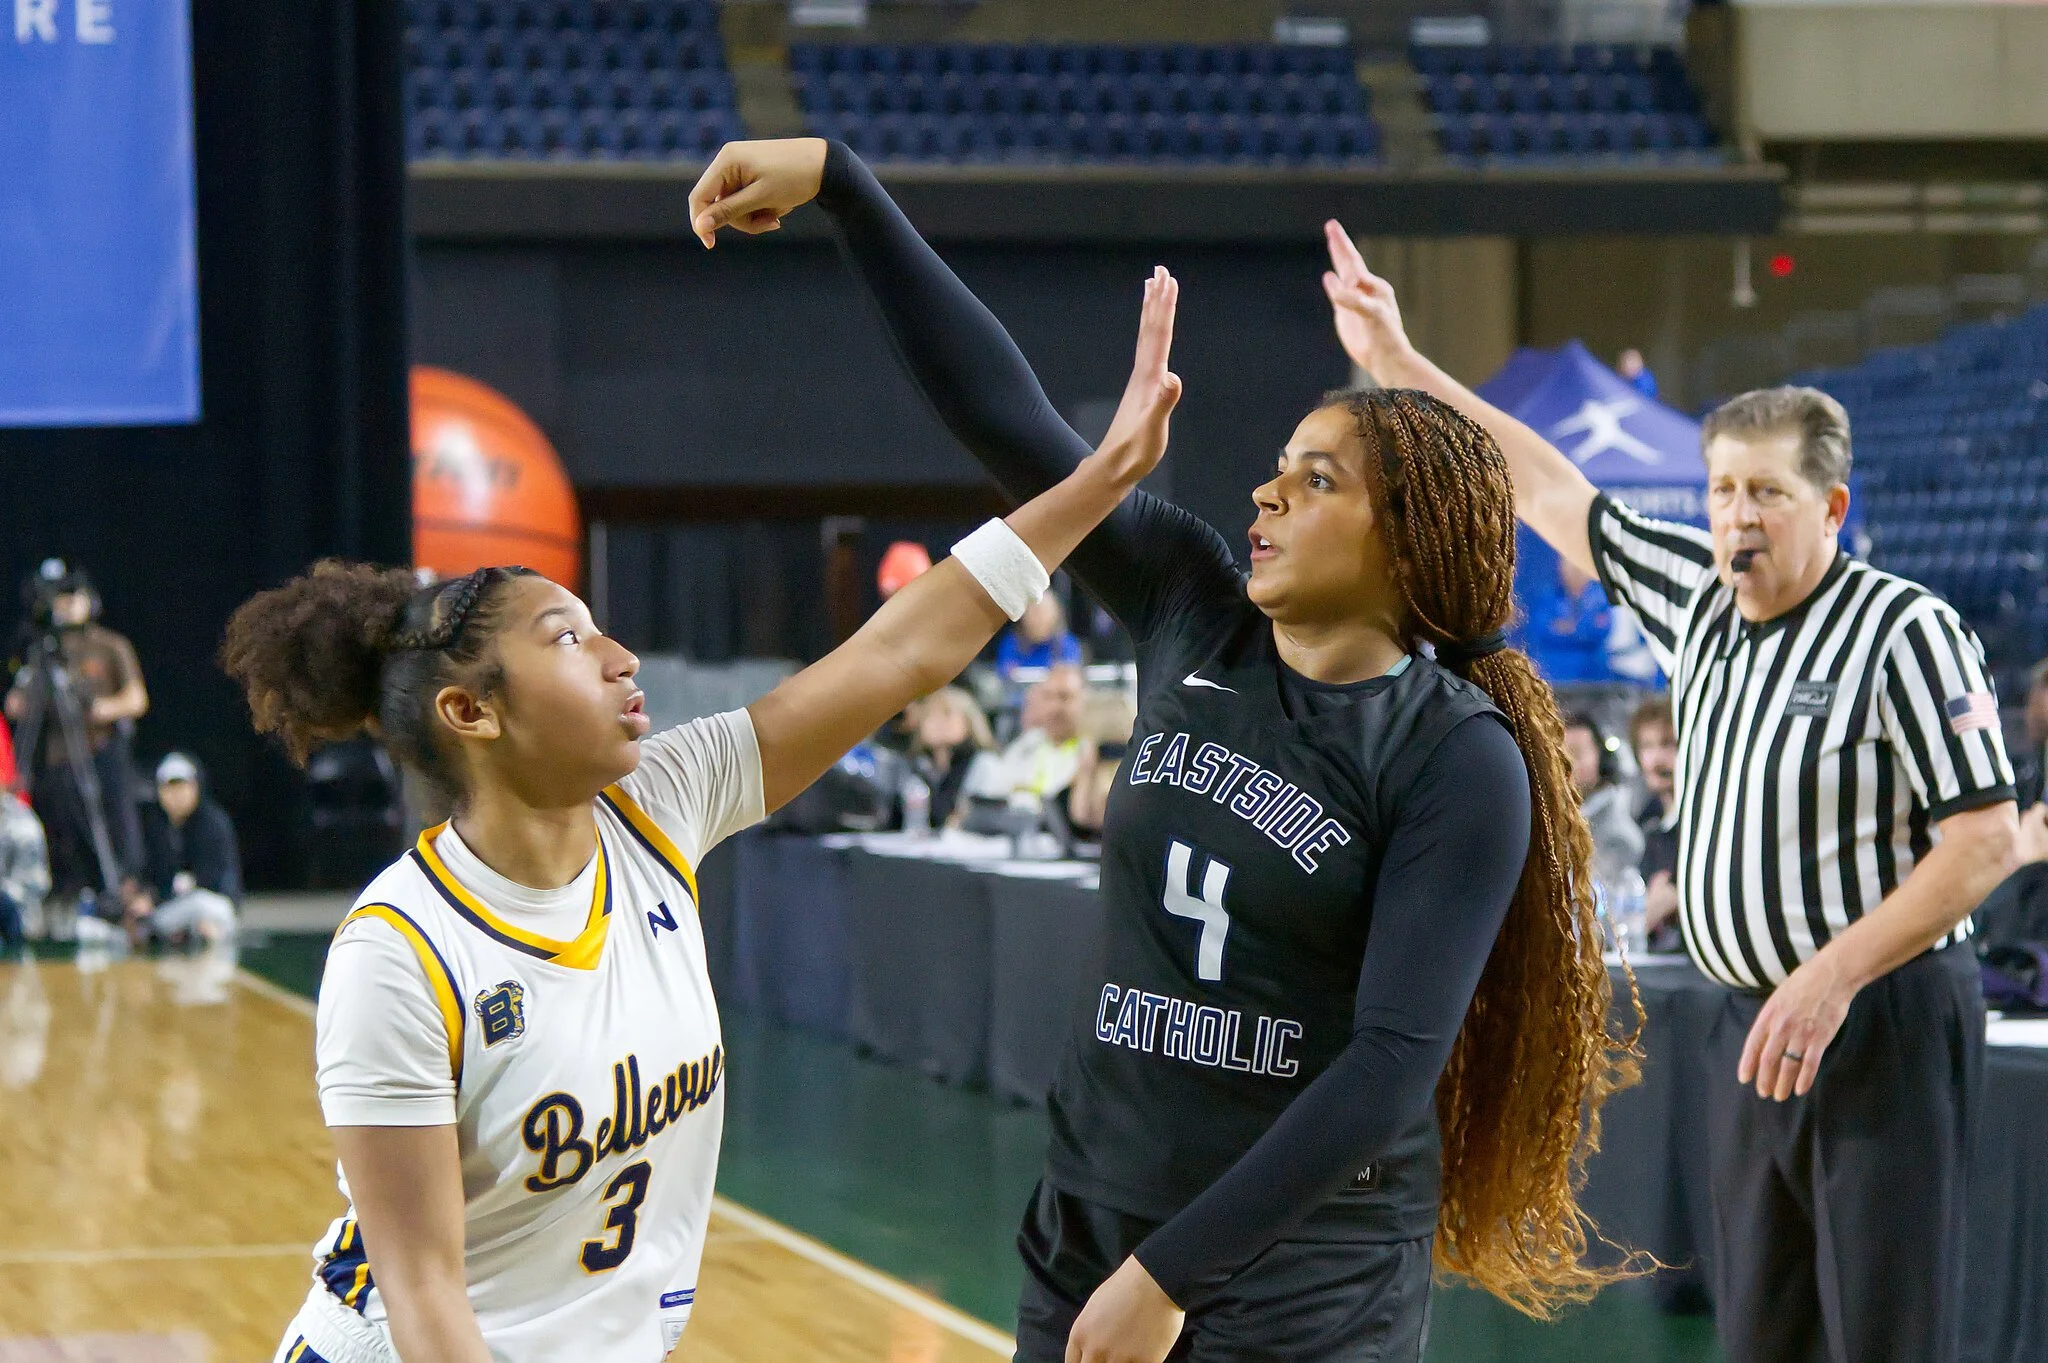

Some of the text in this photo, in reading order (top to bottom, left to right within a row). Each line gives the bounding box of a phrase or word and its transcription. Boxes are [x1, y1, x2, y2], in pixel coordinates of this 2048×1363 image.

[1129, 732, 1351, 875] EASTSIDE
[1161, 836, 1232, 983] 4
[1095, 982, 1304, 1078] CATHOLIC
[578, 1158, 652, 1276] 3
